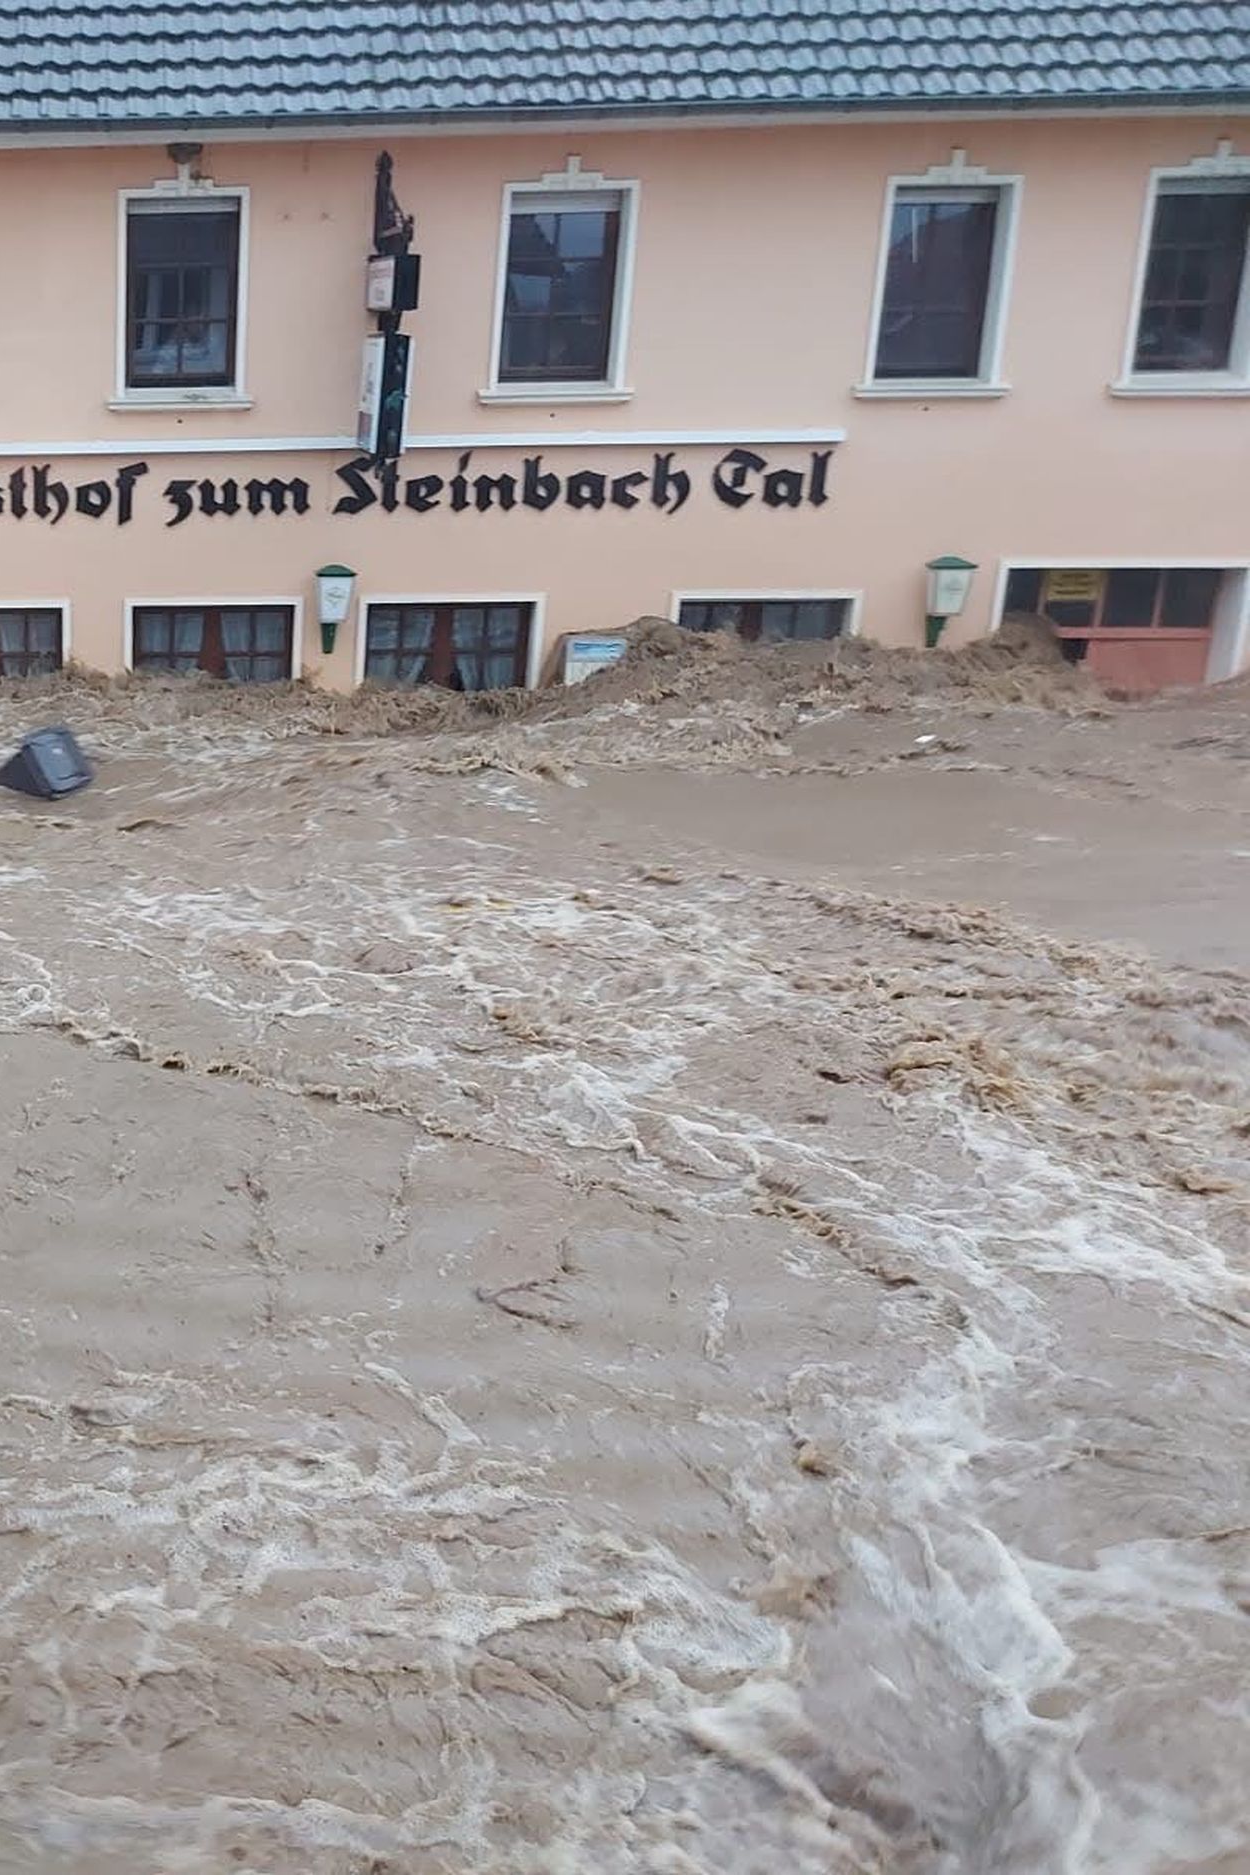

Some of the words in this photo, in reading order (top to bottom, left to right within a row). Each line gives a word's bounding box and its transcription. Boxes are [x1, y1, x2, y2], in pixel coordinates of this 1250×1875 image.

[162, 476, 310, 527] zum
[332, 451, 691, 515] Steinbach
[713, 448, 833, 509] Tal
